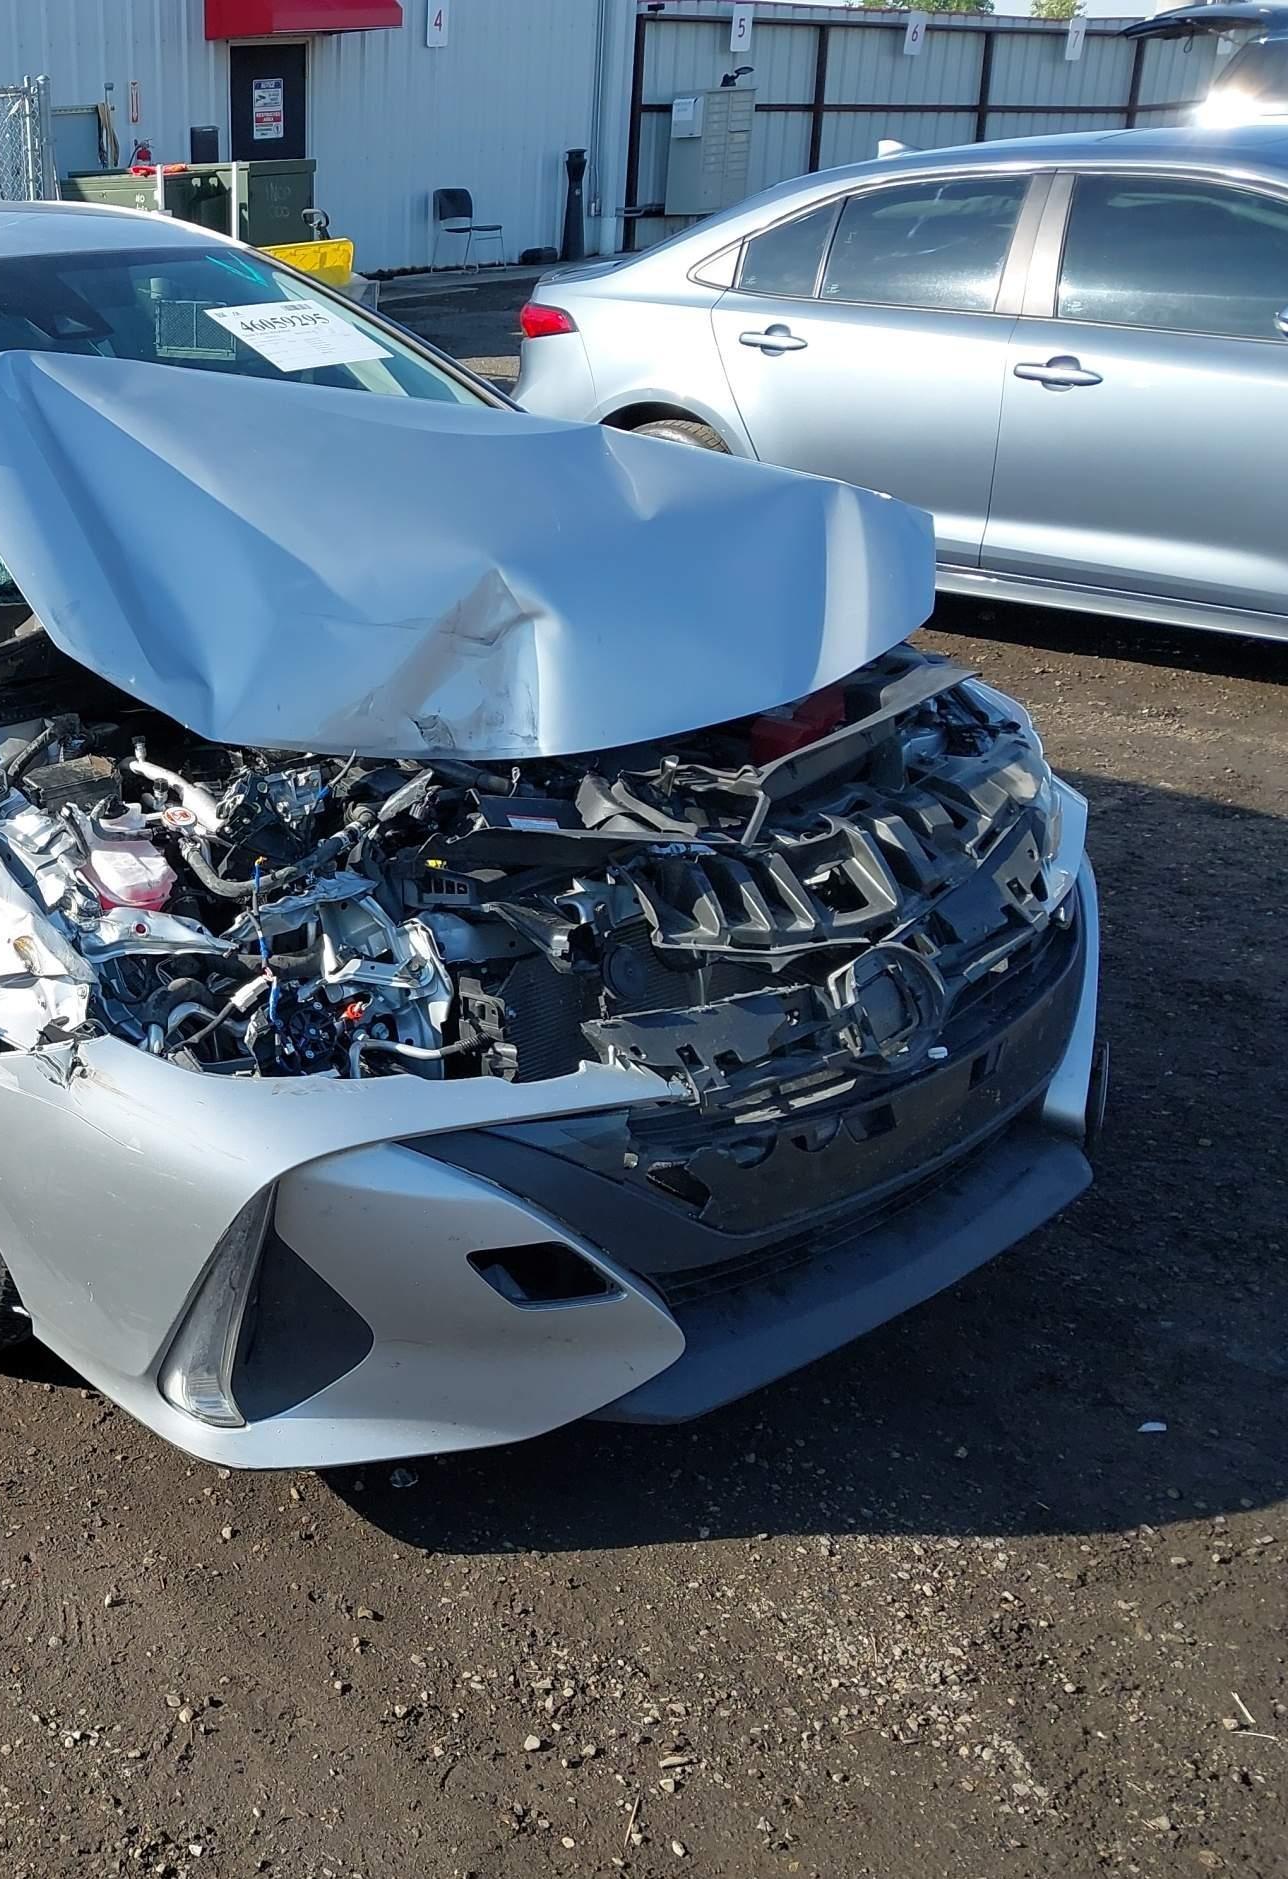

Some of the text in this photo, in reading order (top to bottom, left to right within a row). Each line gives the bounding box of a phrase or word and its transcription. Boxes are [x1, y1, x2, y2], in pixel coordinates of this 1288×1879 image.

[433, 9, 443, 32] 4
[737, 18, 746, 38] 5
[911, 23, 920, 42] 6
[1073, 30, 1080, 49] 7
[239, 313, 330, 333] 46059295
